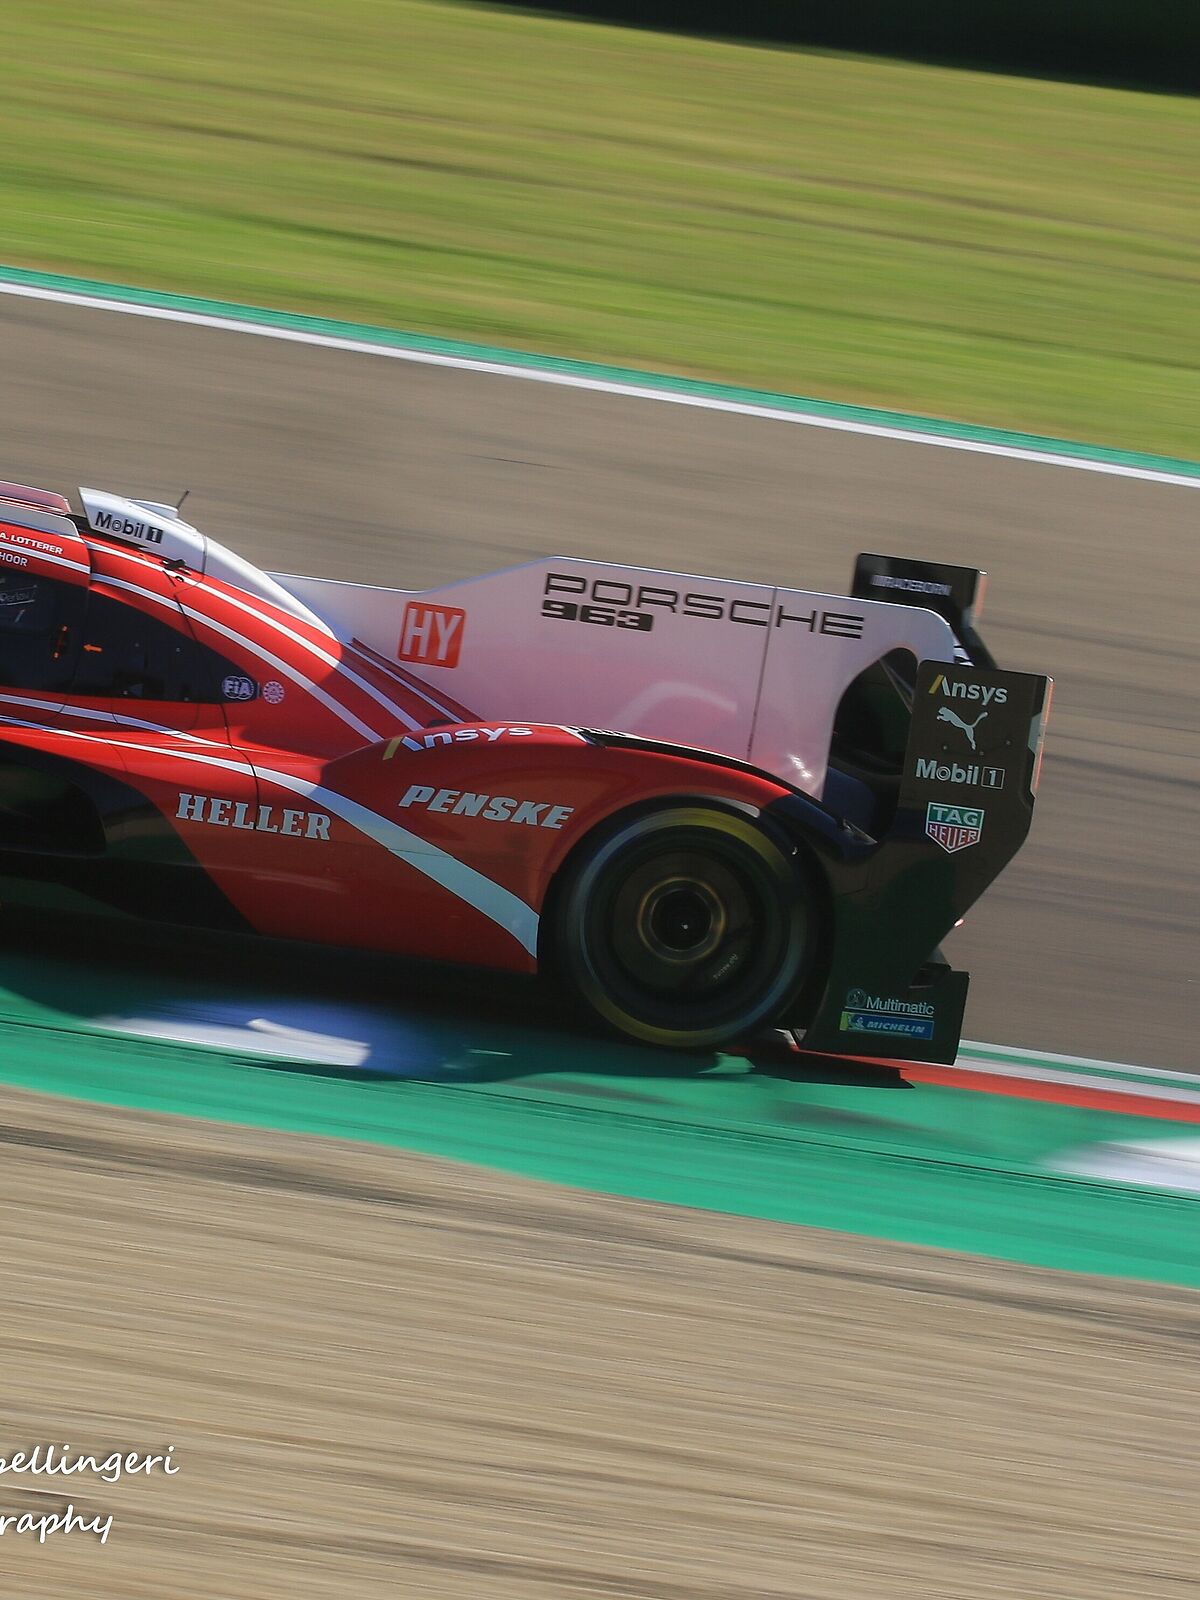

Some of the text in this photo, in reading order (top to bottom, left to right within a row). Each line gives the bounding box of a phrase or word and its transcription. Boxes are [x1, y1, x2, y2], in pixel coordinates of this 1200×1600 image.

[94, 511, 145, 539] Mobil
[0, 532, 63, 555] A. LOTTERER
[541, 599, 654, 632] 963
[544, 572, 865, 640] PORSCHE
[401, 607, 462, 661] HY
[928, 674, 1008, 706] Ansys
[382, 724, 534, 760] Ansys
[915, 758, 979, 786] Mobil
[176, 792, 331, 841] HELLER
[398, 784, 575, 831] PENSKE
[932, 806, 979, 827] TAG
[929, 824, 979, 850] HEUER
[866, 996, 935, 1015] Multimatic
[866, 1021, 926, 1033] MICHELIN
